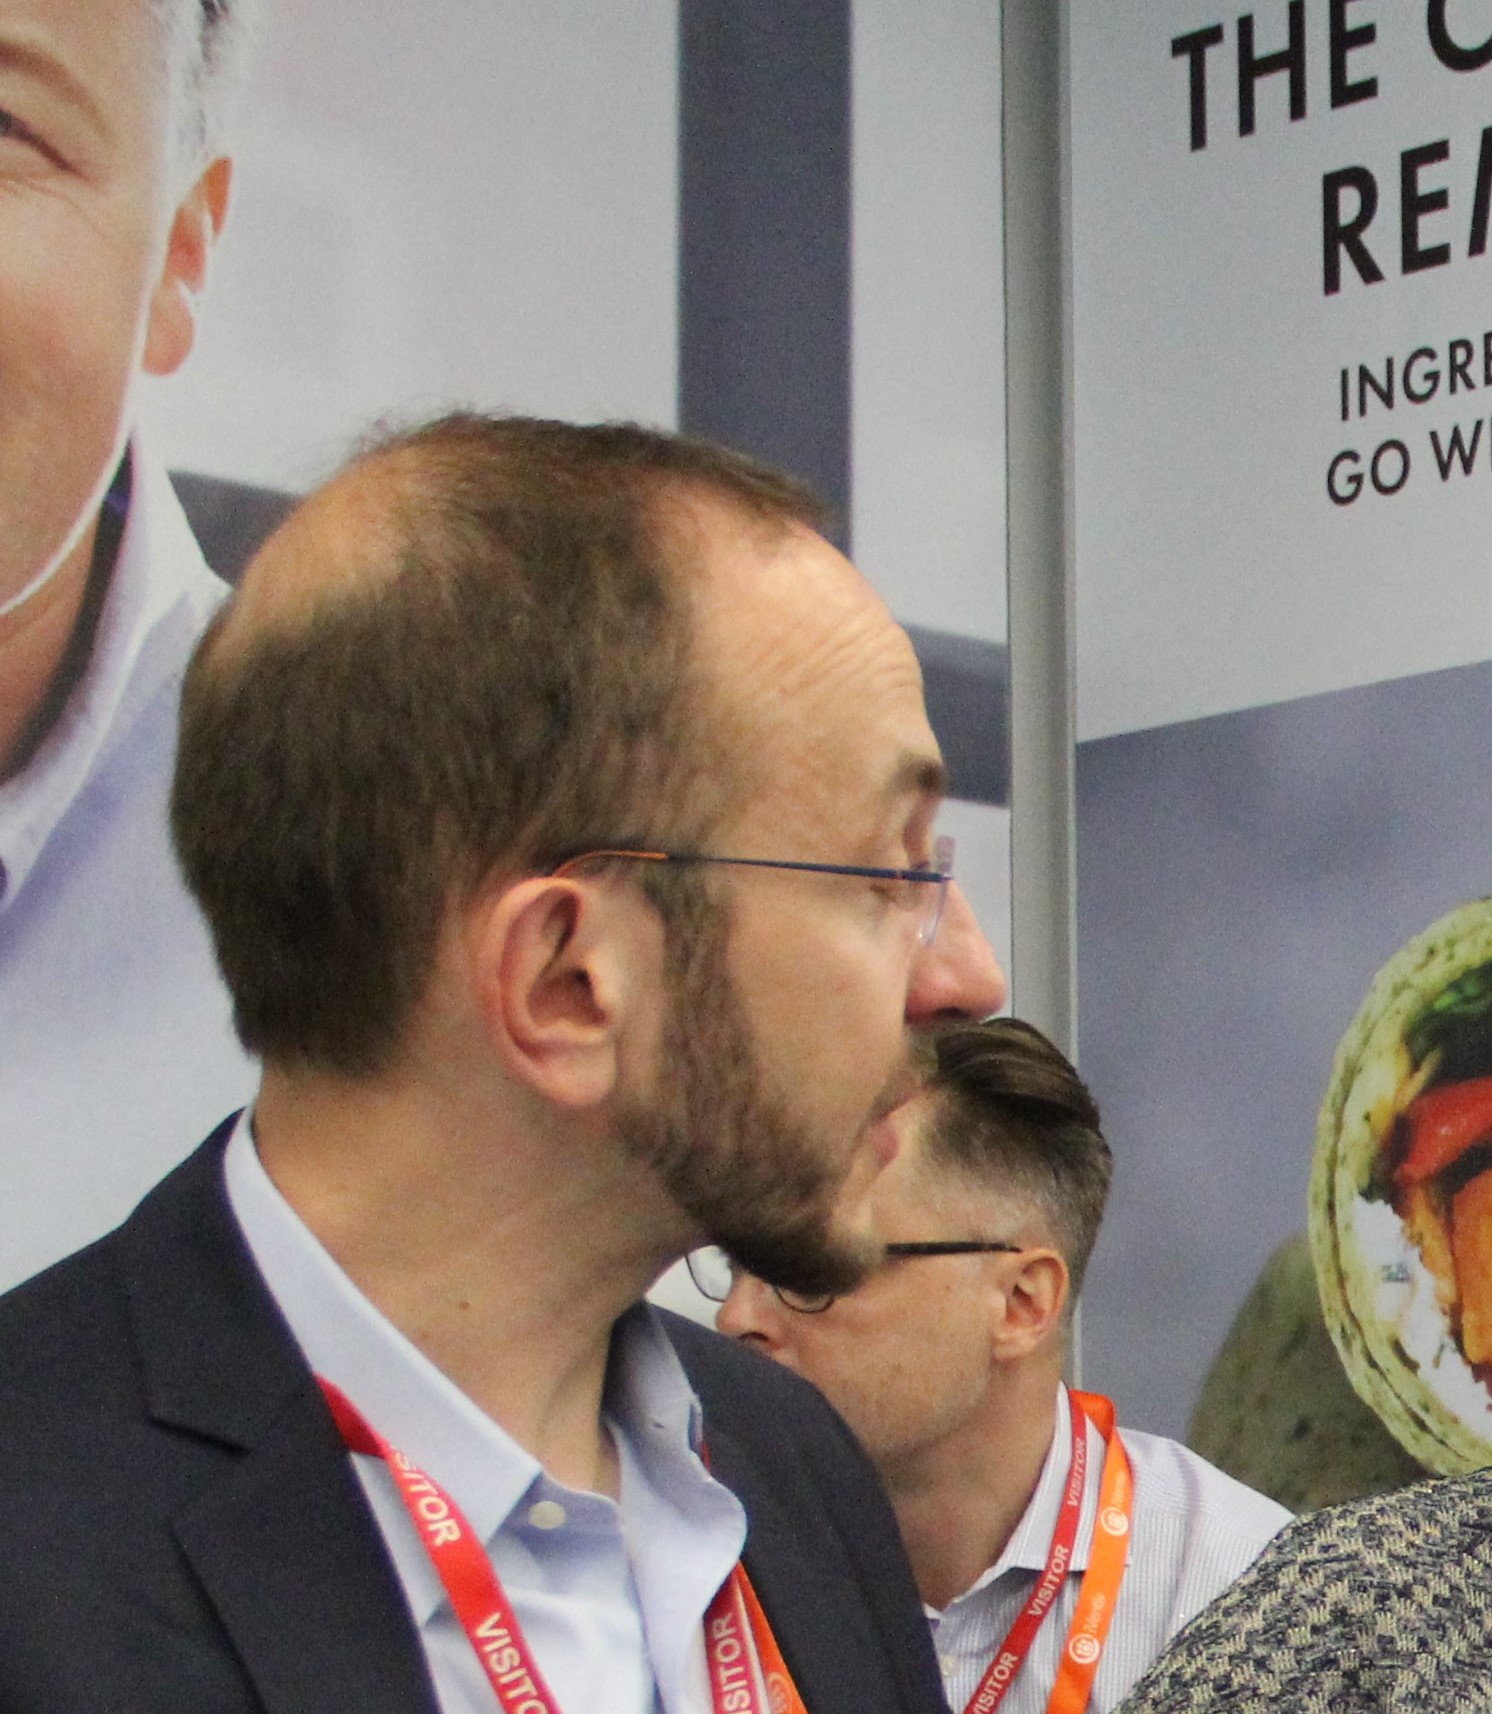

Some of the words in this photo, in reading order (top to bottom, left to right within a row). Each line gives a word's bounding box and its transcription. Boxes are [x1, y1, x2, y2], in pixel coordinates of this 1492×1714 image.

[1171, 0, 1378, 151] THE
[1326, 438, 1410, 507] GO
[1028, 1543, 1070, 1617] VISITOR
